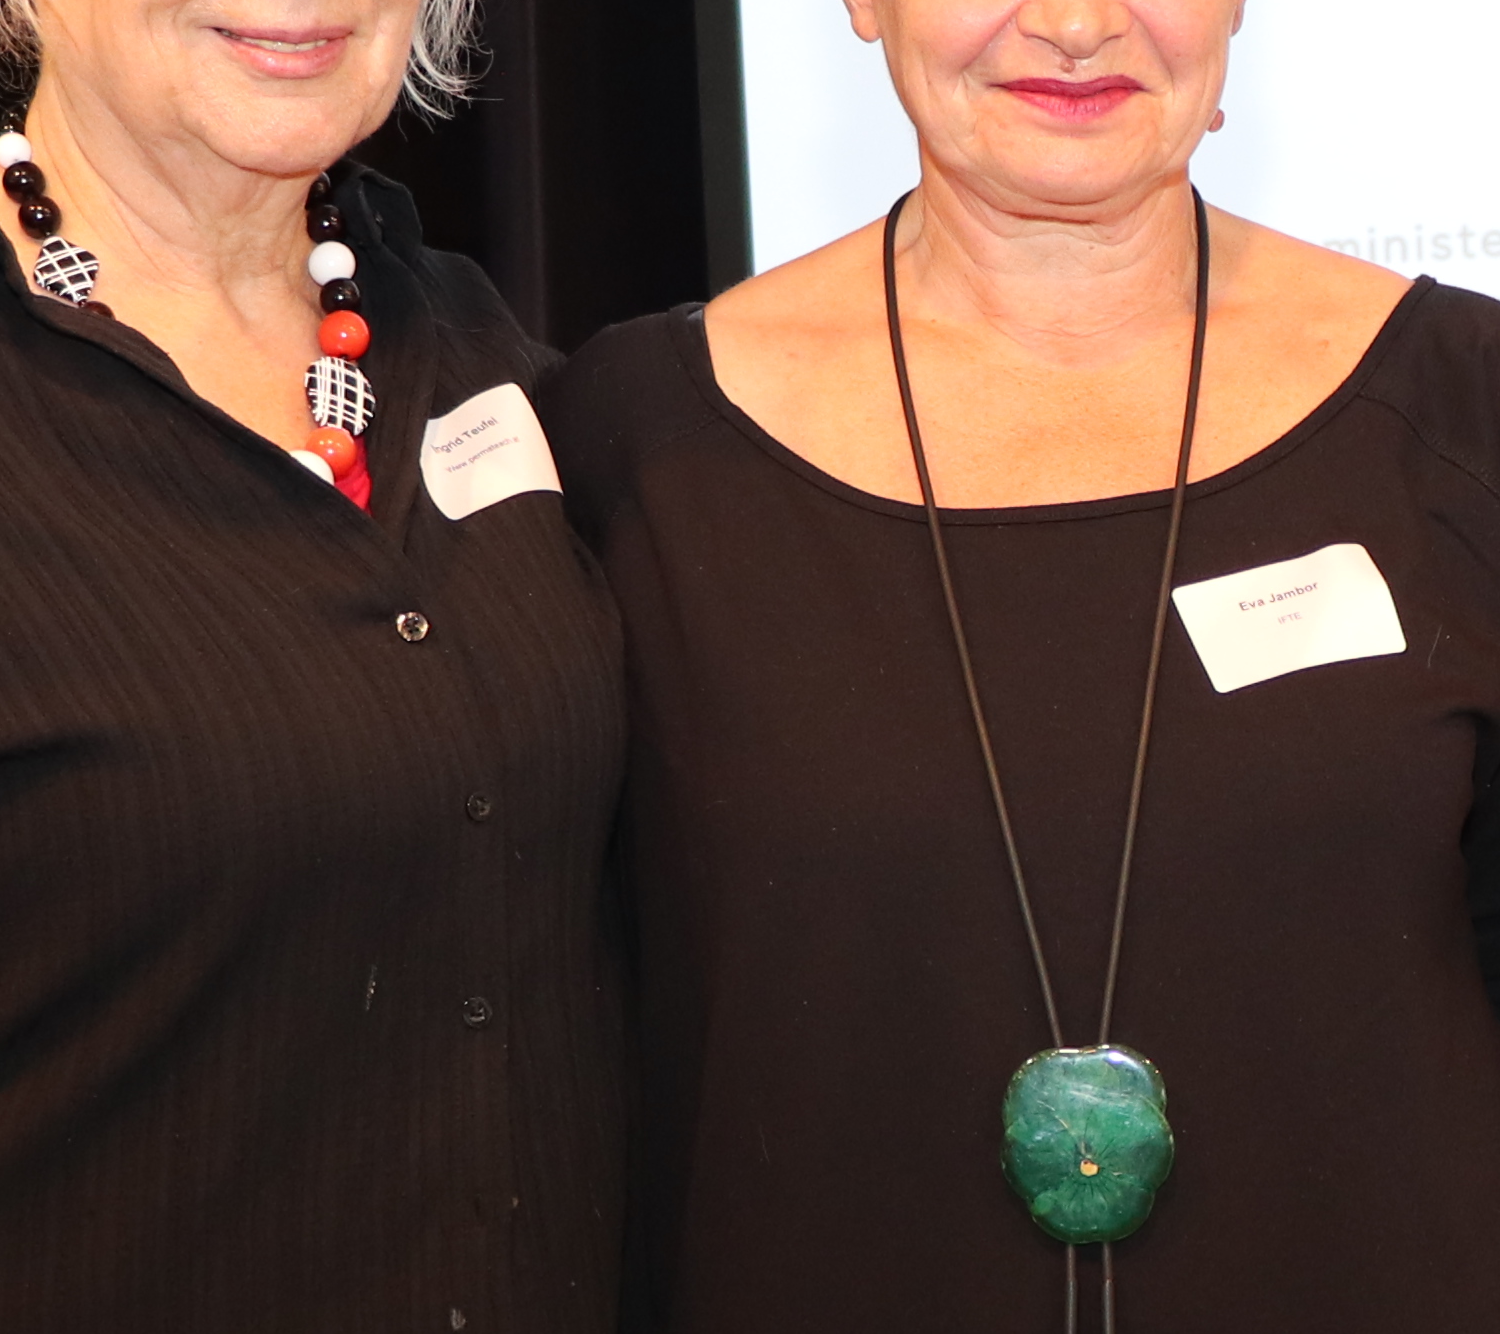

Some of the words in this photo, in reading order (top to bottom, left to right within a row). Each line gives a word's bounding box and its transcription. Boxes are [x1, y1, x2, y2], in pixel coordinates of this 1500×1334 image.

[461, 416, 499, 439] Teufel
[1238, 598, 1266, 612] Eva
[1268, 581, 1319, 604] Jambor
